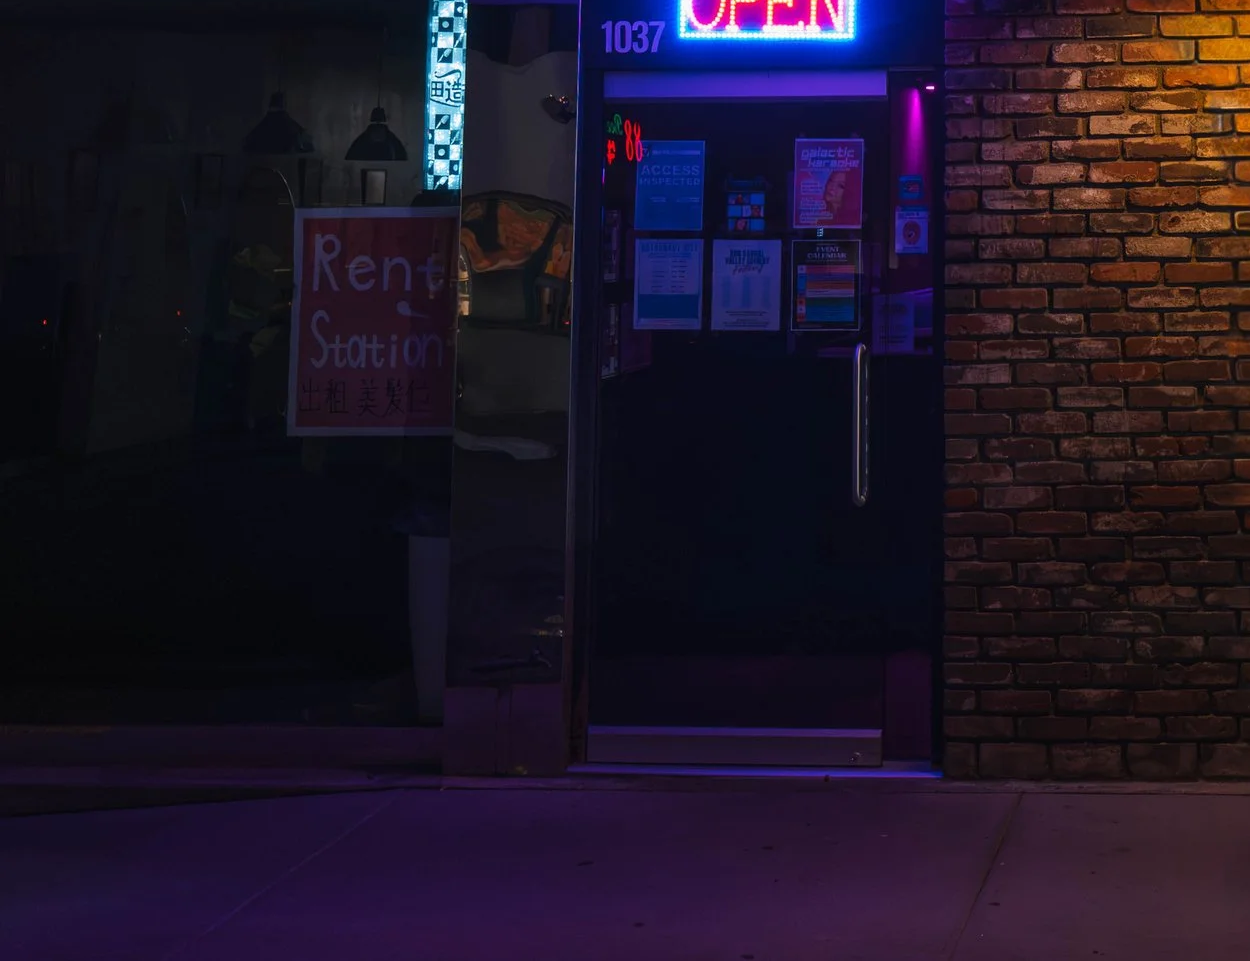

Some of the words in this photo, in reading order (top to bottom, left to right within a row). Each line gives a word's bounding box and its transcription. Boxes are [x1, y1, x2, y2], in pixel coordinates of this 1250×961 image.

[601, 20, 665, 54] 1037
[639, 177, 701, 187] INSPECTED
[641, 165, 700, 176] ACCESS
[312, 233, 444, 293] Rent
[310, 309, 443, 370] Station
